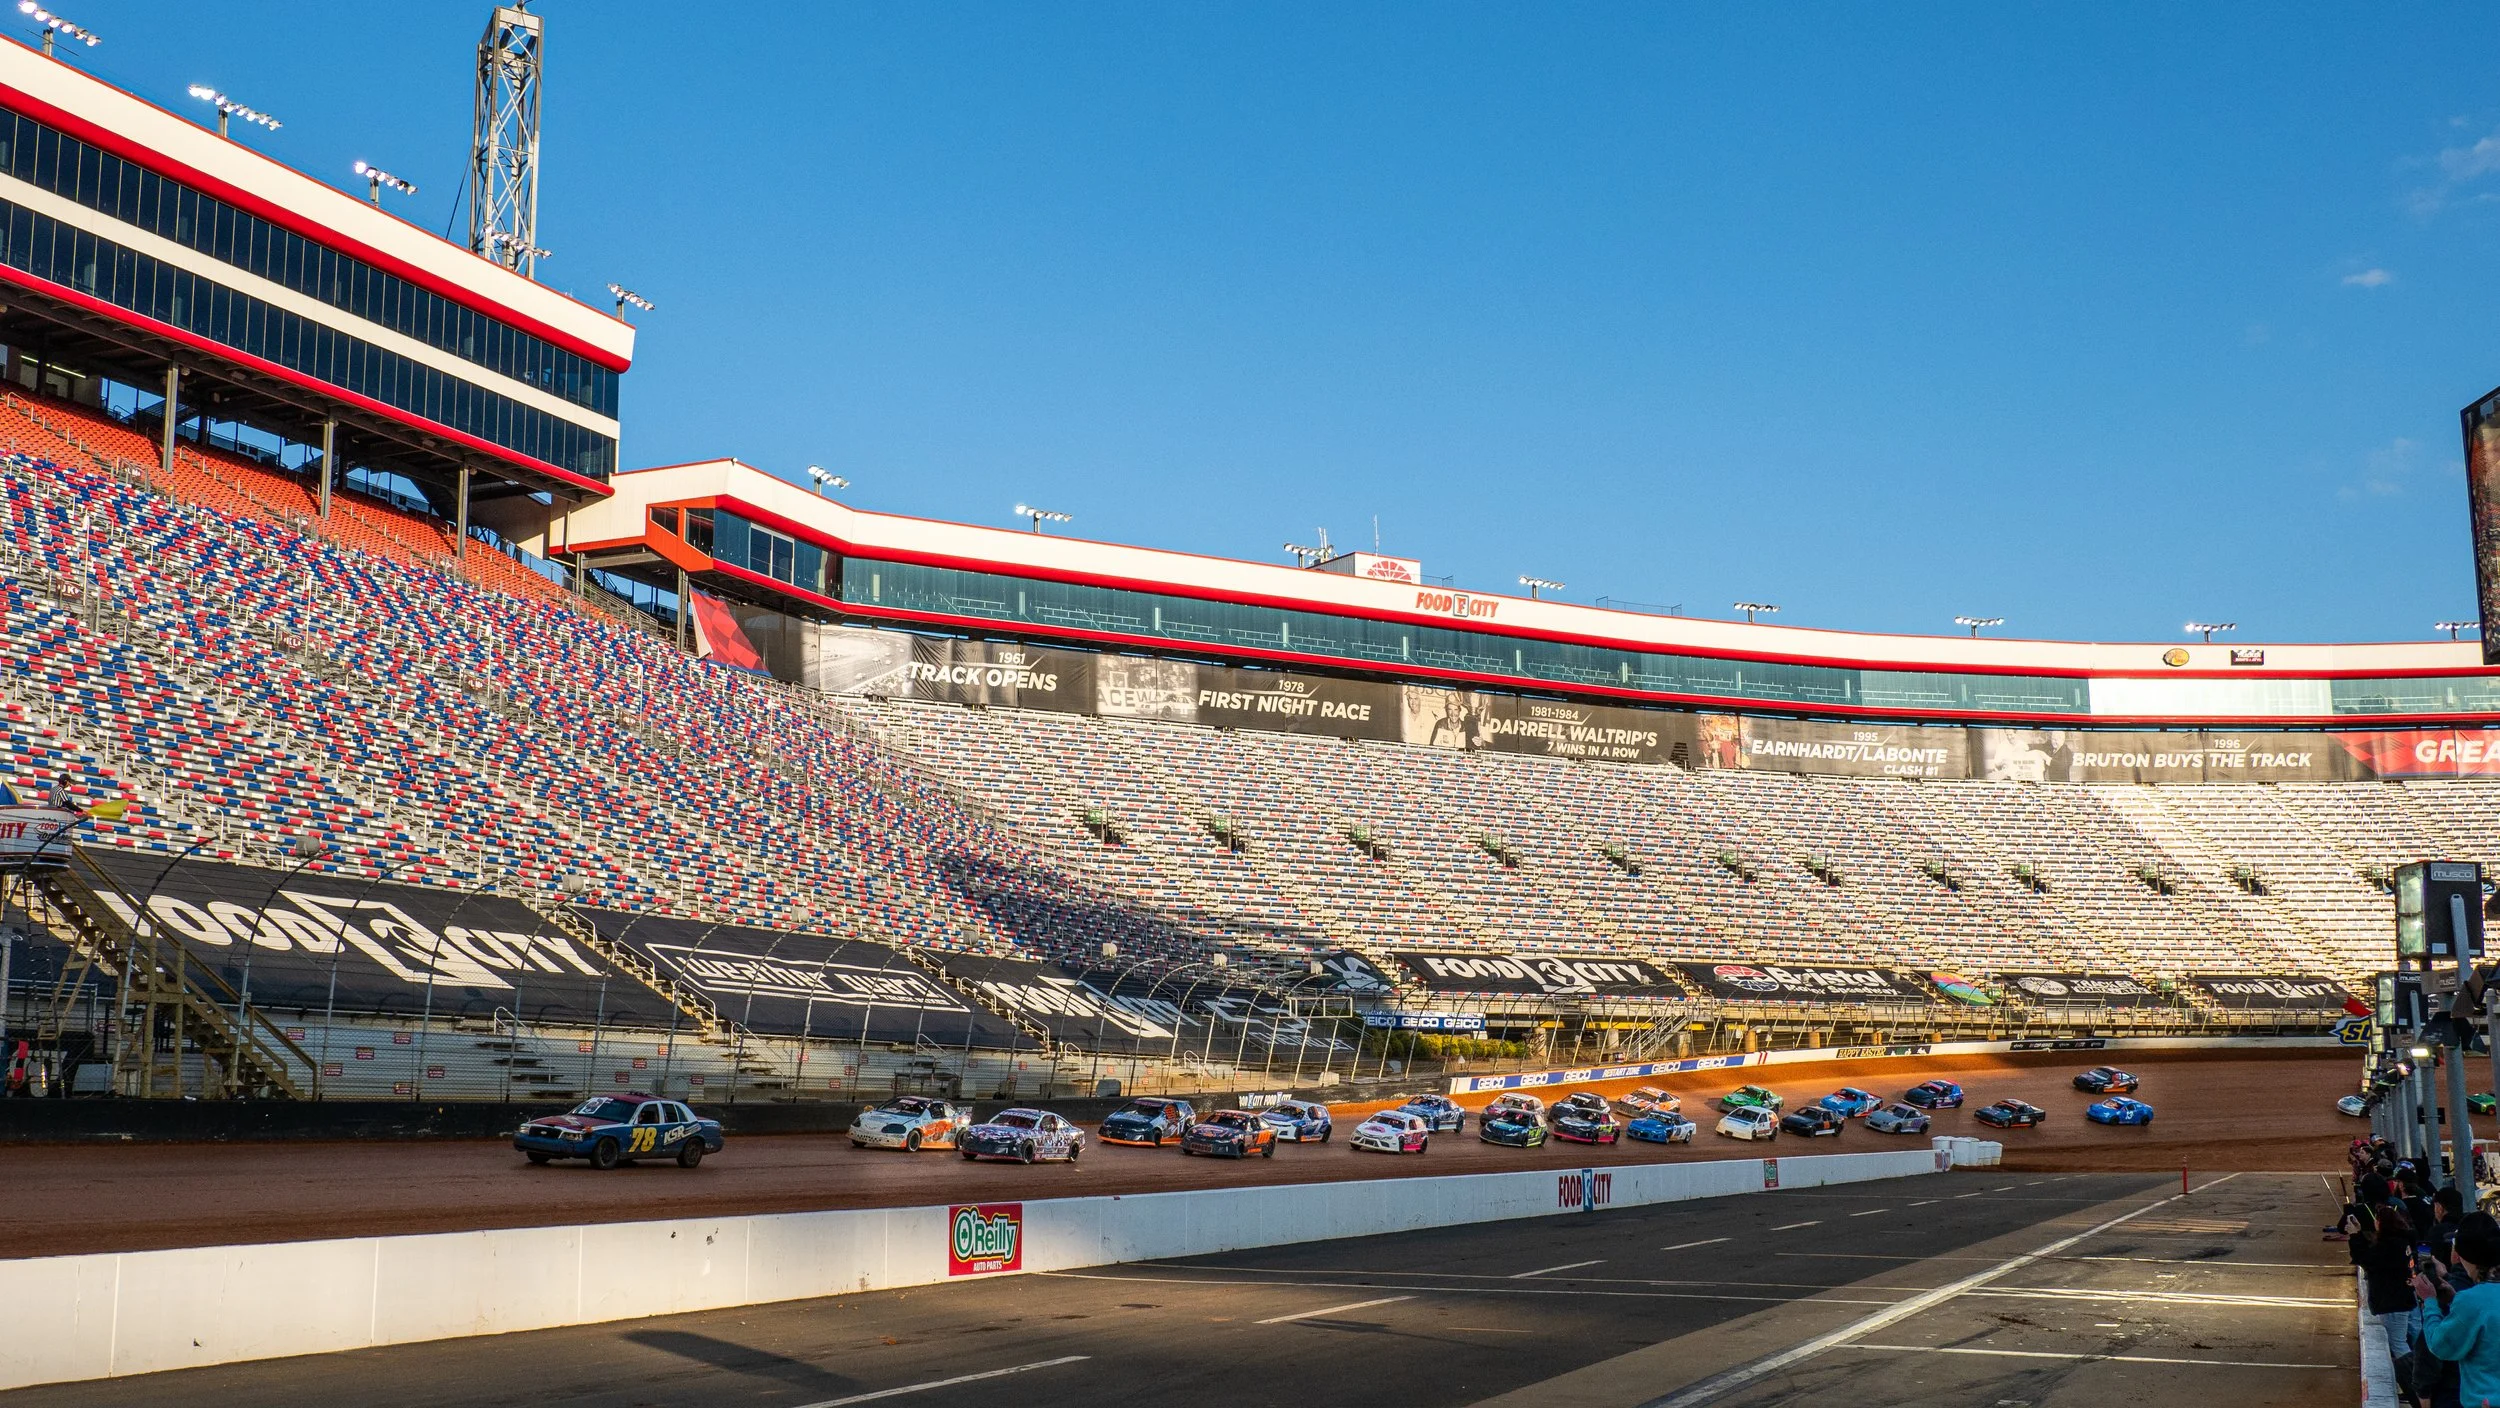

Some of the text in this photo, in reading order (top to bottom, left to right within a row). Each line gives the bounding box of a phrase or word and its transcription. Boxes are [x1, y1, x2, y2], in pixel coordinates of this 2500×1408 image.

[1415, 591, 1499, 618] FOOD CITY
[998, 652, 1026, 665] 1961
[909, 661, 1058, 692] TRACK OPENS
[1278, 679, 1305, 693] 1978
[1198, 689, 1371, 721] FIRST NIGHT RACE
[1530, 705, 1579, 720] 1981-1984
[1490, 717, 1658, 747] DARRELL WALTRIP'S
[1853, 731, 1879, 742] 1995
[1547, 741, 1640, 759] 7 WINS IN A ROW
[2213, 739, 2241, 748] 1996
[1751, 740, 1948, 764] EARNHARDT/LABONTE
[2072, 752, 2312, 768] BRUTON BUYS THE TRACK
[1883, 764, 1939, 776] CLASH #1
[444, 925, 604, 976] CITY
[676, 956, 834, 991] weather
[1423, 957, 1650, 983] FOOD CITY
[1765, 966, 1891, 987] Bristol
[2210, 983, 2266, 994] FOOD
[1401, 1017, 1439, 1027] GEICO
[1443, 1018, 1481, 1029] GEICO
[1838, 1047, 1887, 1058] HAPPY EASTER
[1651, 1061, 1681, 1074] GEICO
[1697, 1056, 1727, 1069] GEICO
[1520, 1072, 1548, 1086] GEICO
[1563, 1069, 1592, 1082] GEICO
[1602, 1066, 1641, 1079] RESTART ZONE
[1477, 1076, 1505, 1090] GEICO
[628, 1127, 657, 1153] 78
[664, 1125, 685, 1146] KSR
[1558, 1173, 1612, 1208] FOOD CITY
[955, 1210, 1017, 1259] O'Reilly
[973, 1260, 1003, 1272] AUTO PARTS
